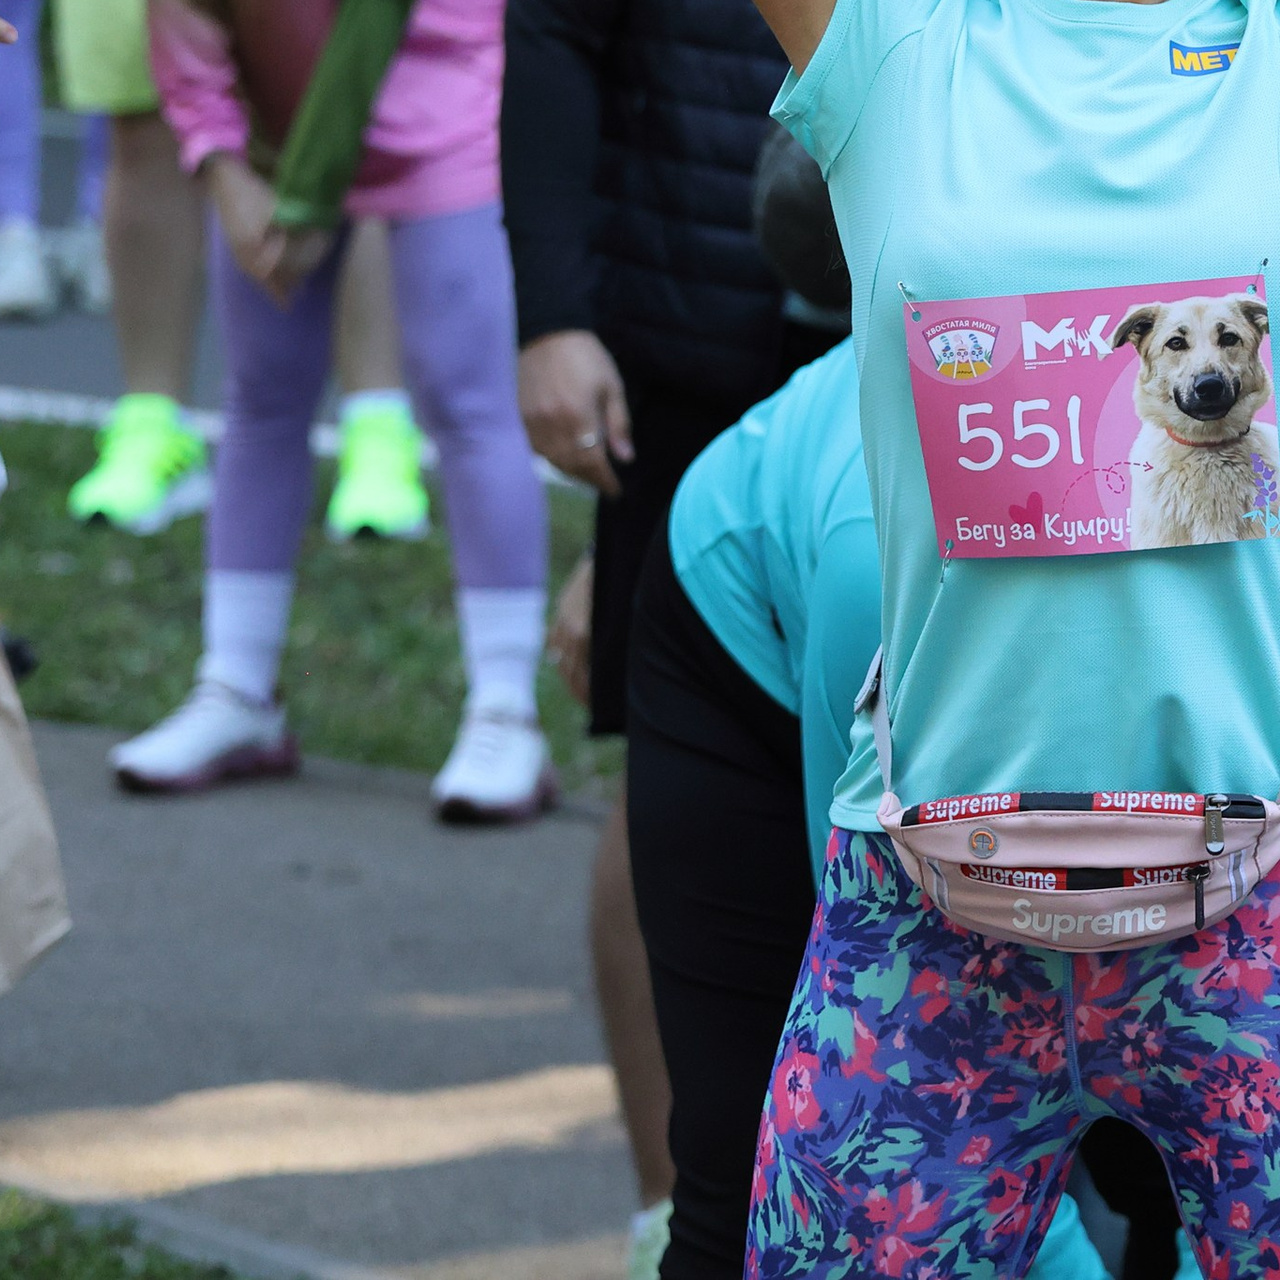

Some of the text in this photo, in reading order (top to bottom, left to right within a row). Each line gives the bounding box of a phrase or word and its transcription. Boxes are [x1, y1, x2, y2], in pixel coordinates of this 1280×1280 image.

[926, 320, 996, 337] ХВОСТАТАЯ МИЛЯ
[957, 395, 1084, 471] 551
[956, 507, 1132, 548] Бегу за Кумру!
[925, 792, 1197, 820] Supreme Supreme
[1133, 865, 1197, 887] Supre
[1012, 898, 1167, 940] Supreme
